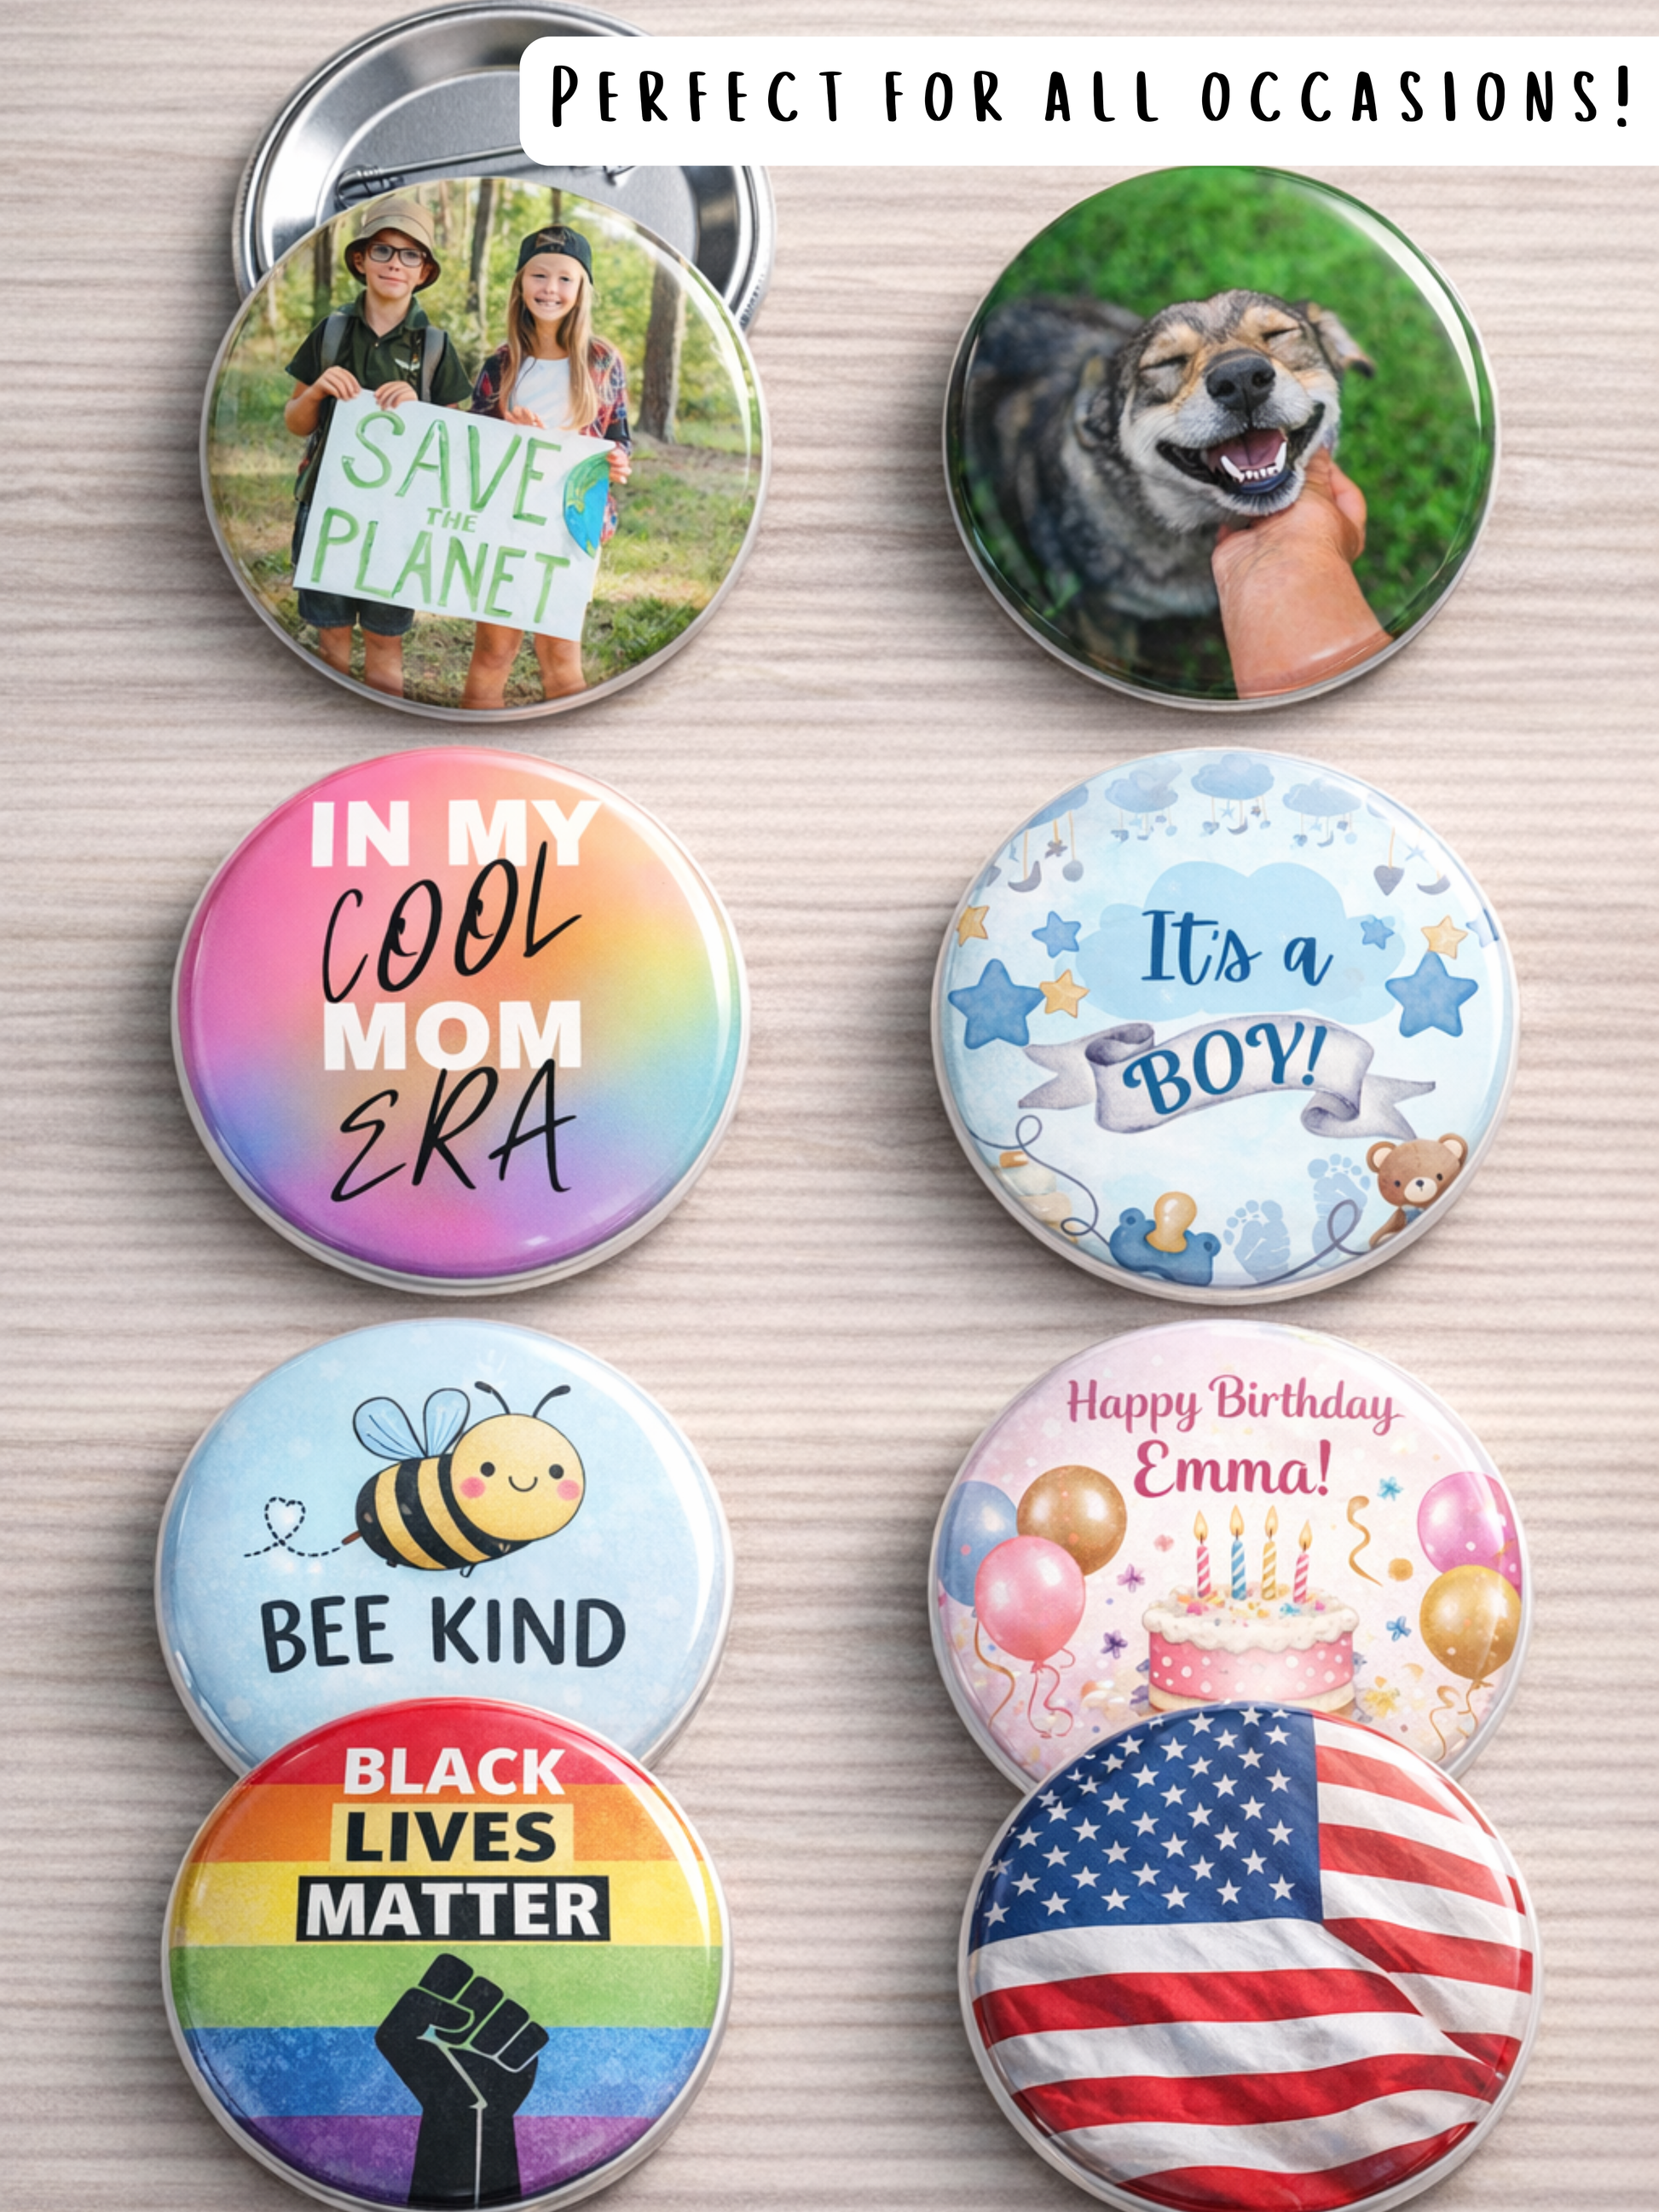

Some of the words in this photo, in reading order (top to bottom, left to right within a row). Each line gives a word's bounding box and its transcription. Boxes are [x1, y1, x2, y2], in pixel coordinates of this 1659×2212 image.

[341, 411, 563, 527] SAVE
[426, 507, 477, 534] THE
[309, 507, 571, 624] PLANET
[310, 800, 410, 868] IN
[448, 799, 602, 867] MY
[321, 840, 583, 1004] COOL
[1141, 909, 1263, 985] It's
[1282, 936, 1334, 987] a
[323, 1000, 582, 1071] MOM
[1121, 1020, 1330, 1115] BOY!
[330, 1058, 578, 1203] ERA
[1066, 1378, 1203, 1435] Happy
[1207, 1374, 1407, 1436] Birthday
[1132, 1439, 1333, 1499] Emma!
[260, 1595, 395, 1674] BEE
[431, 1596, 627, 1668] KIND
[343, 1747, 567, 1796] BLACK
[344, 1811, 557, 1864] LIVES
[304, 1882, 601, 1938] MATTER
